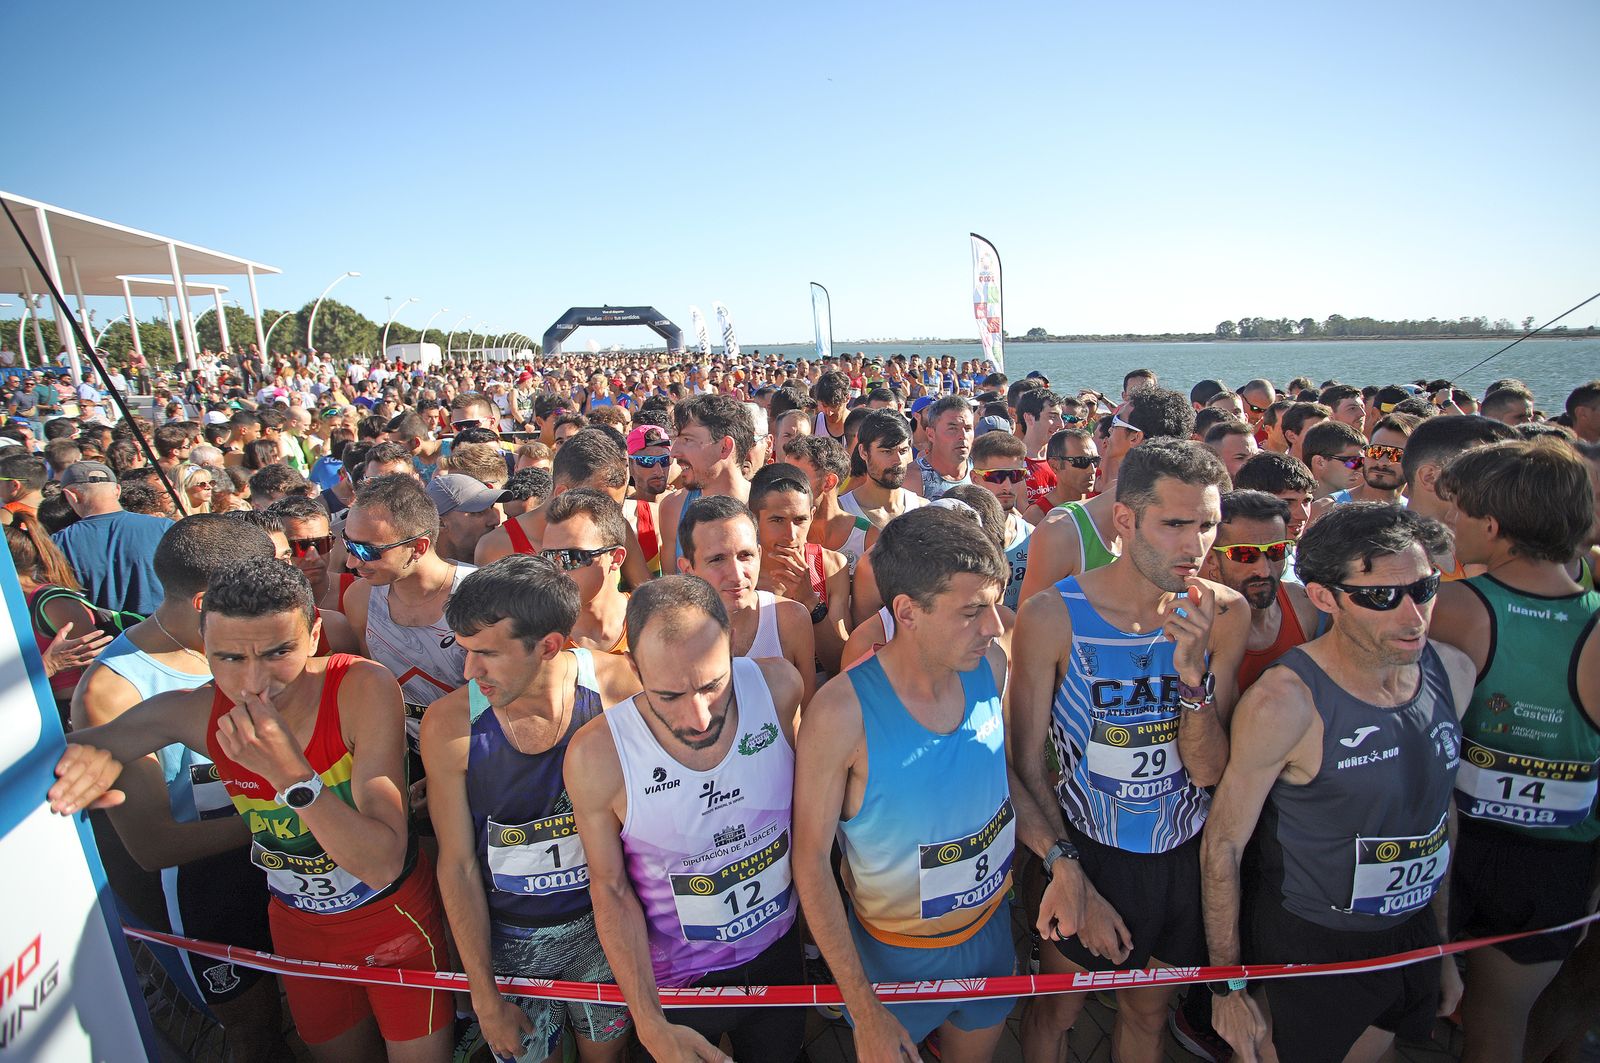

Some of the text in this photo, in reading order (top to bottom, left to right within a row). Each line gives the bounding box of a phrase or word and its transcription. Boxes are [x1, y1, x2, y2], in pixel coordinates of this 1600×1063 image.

[1507, 603, 1551, 620] luanvi
[1106, 704, 1155, 717] ATLETISMO
[1513, 706, 1564, 723] Castelló
[1137, 720, 1179, 735] RUNNIN
[1130, 748, 1167, 779] 29
[1337, 755, 1369, 770] NÚÑEZ
[1507, 756, 1591, 773] RUNNING
[644, 778, 681, 795] VIATOR
[1525, 769, 1575, 781] LOOP
[1115, 777, 1174, 799] Joma
[1495, 776, 1546, 805] 14
[533, 815, 574, 831] RUNN
[1471, 799, 1557, 823] Joma
[552, 825, 578, 838] LOO
[968, 806, 1008, 847] RUNNING
[982, 823, 1003, 850] LOOP
[1409, 823, 1447, 849] RUNNING
[544, 843, 561, 869] 1
[682, 823, 778, 867] DIPUTACIÓN DE ALBACETE
[304, 862, 335, 874] LOO
[721, 840, 781, 879] RUNNING
[739, 856, 774, 881] LOOP
[974, 853, 989, 882] 8
[293, 874, 338, 897] 23
[1385, 856, 1438, 892] 202
[293, 890, 360, 911] Joma
[723, 879, 765, 916] 12
[951, 868, 1004, 910] Joma
[1379, 885, 1433, 914] Joma
[715, 900, 781, 941] Joma
